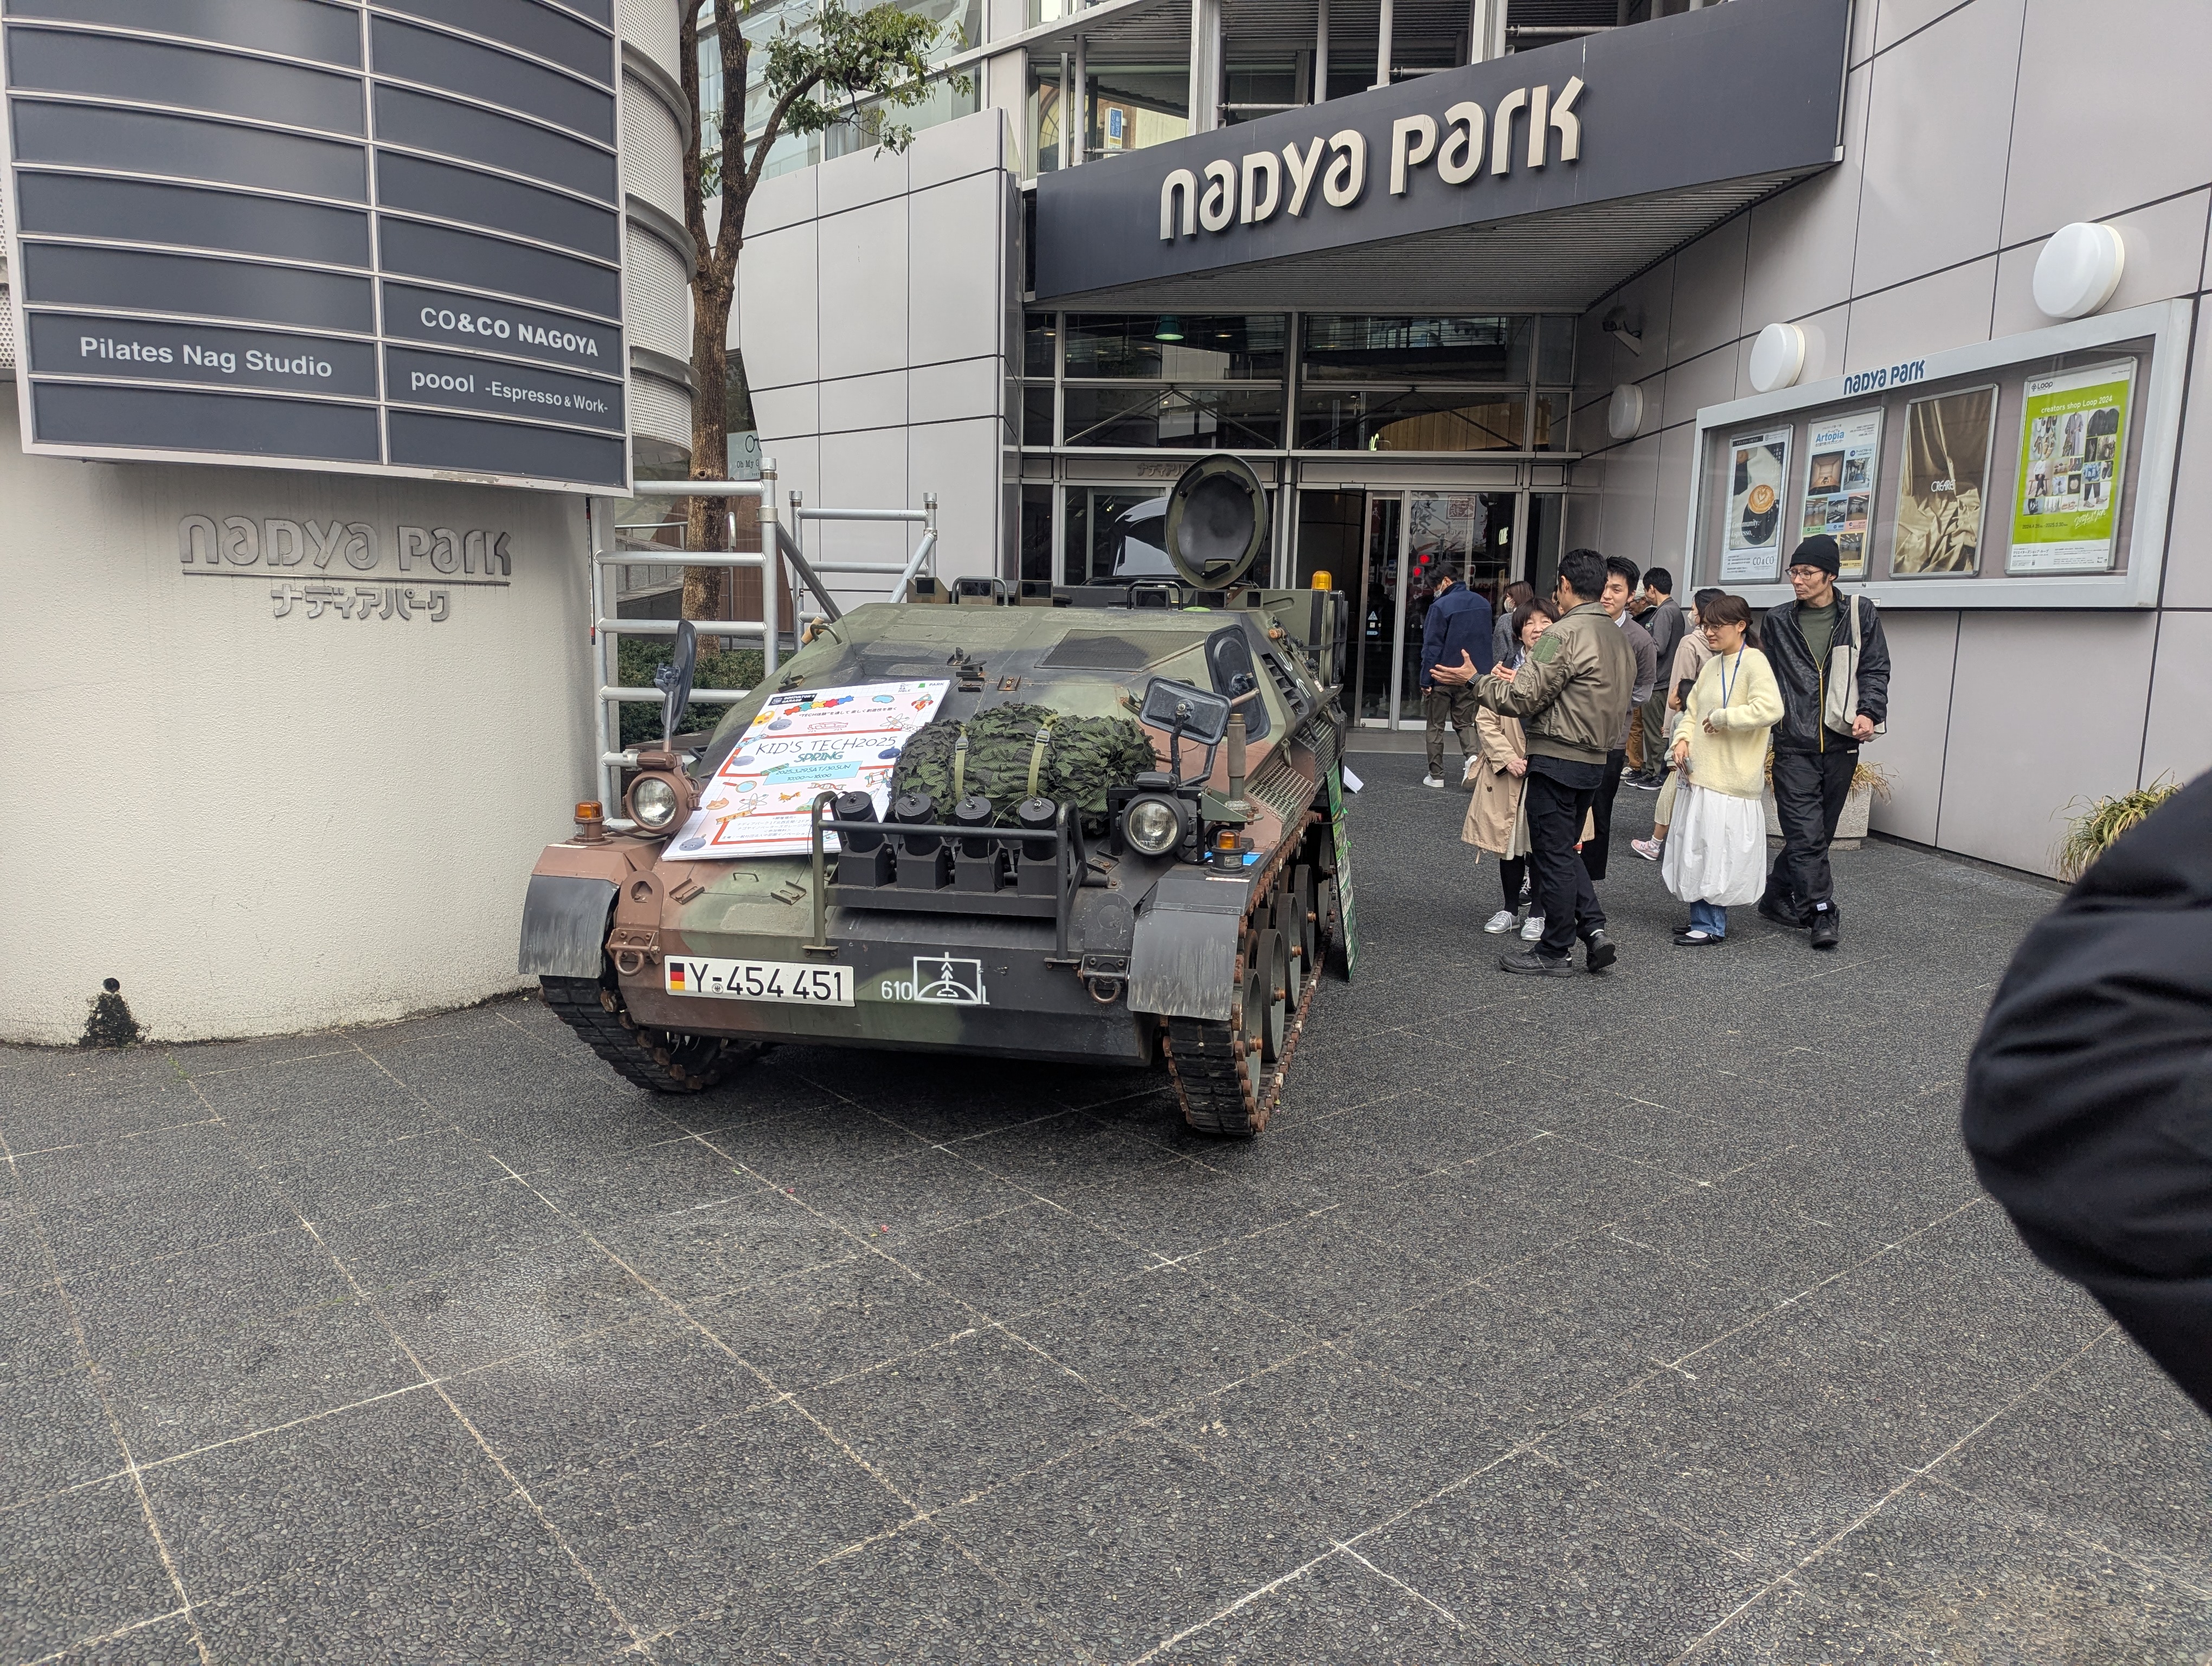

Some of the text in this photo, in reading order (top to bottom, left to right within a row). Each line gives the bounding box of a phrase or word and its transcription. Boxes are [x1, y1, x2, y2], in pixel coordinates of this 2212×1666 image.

[420, 307, 599, 357] CO&CO NAGOYA
[80, 336, 332, 378] Pilates Nag Studio
[410, 368, 608, 414] poool -Espresso & Work-
[2041, 404, 2065, 413] creators
[2099, 395, 2112, 404] 2024
[1816, 431, 1844, 443] Artopia
[745, 460, 754, 469] My
[271, 585, 451, 622] ナディアパーク
[756, 741, 804, 755] KID'S
[794, 751, 844, 762] SPRING
[793, 970, 842, 1002] 451
[882, 981, 912, 1000] 610
